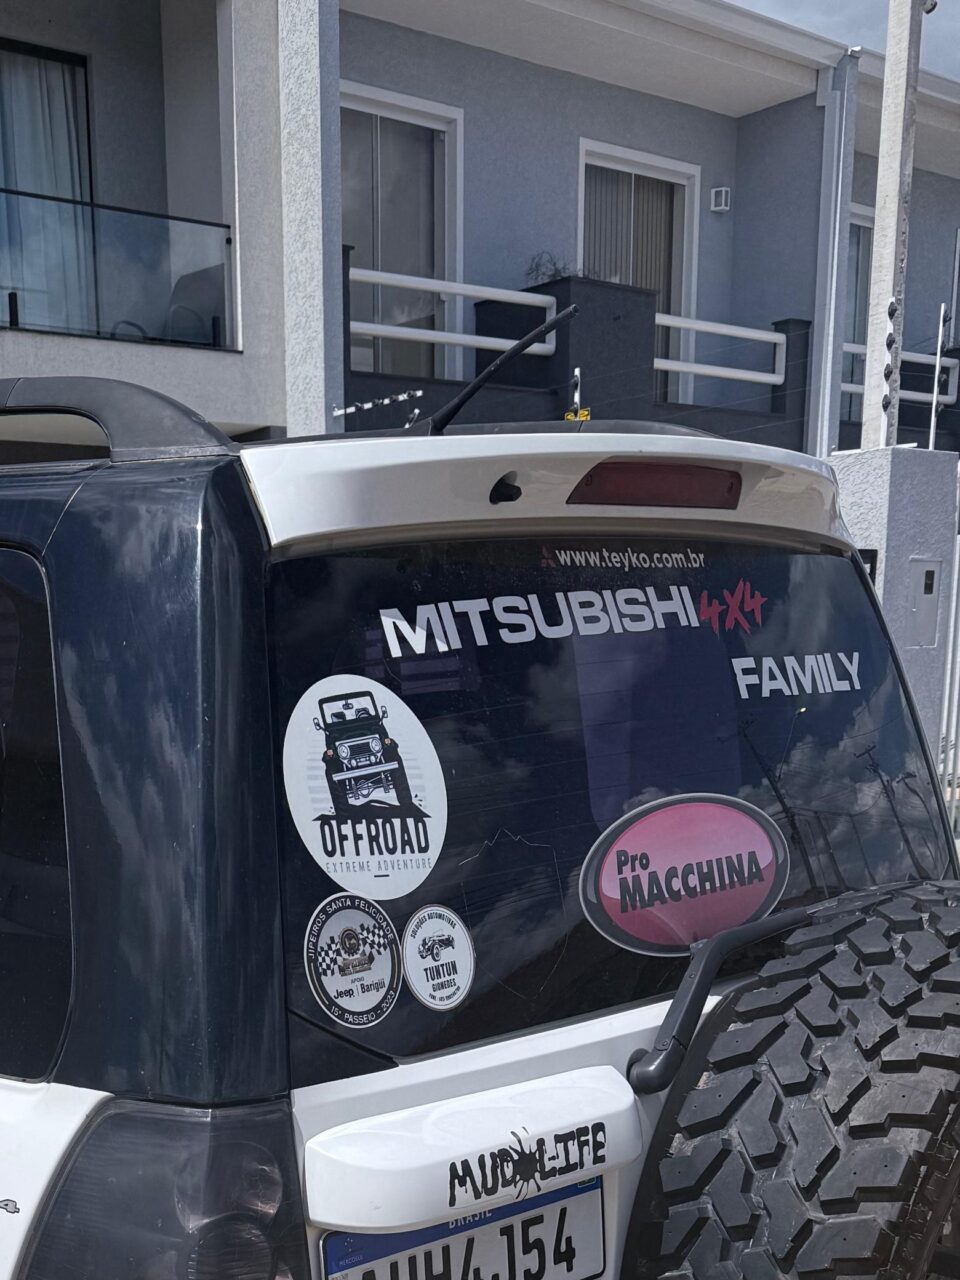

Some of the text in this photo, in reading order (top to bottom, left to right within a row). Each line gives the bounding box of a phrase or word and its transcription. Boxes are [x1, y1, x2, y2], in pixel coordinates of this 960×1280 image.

[556, 548, 704, 572] www.teyko.com.br
[380, 585, 699, 658] MITSUBISHI
[731, 651, 862, 699] FAMILY
[320, 818, 430, 857] OFFROAD
[326, 858, 432, 873] EXTREME ADVENTURE
[615, 849, 649, 876] Pro
[619, 851, 765, 913] MACCHINA
[308, 898, 394, 959] JIPEIROS SANTA FELICIDADE
[424, 960, 458, 982] TUNTUN
[333, 988, 354, 999] Jeep
[344, 1012, 376, 1024] PASSEIO
[381, 990, 395, 1011] 2023
[448, 1121, 607, 1208] MUD LIFE
